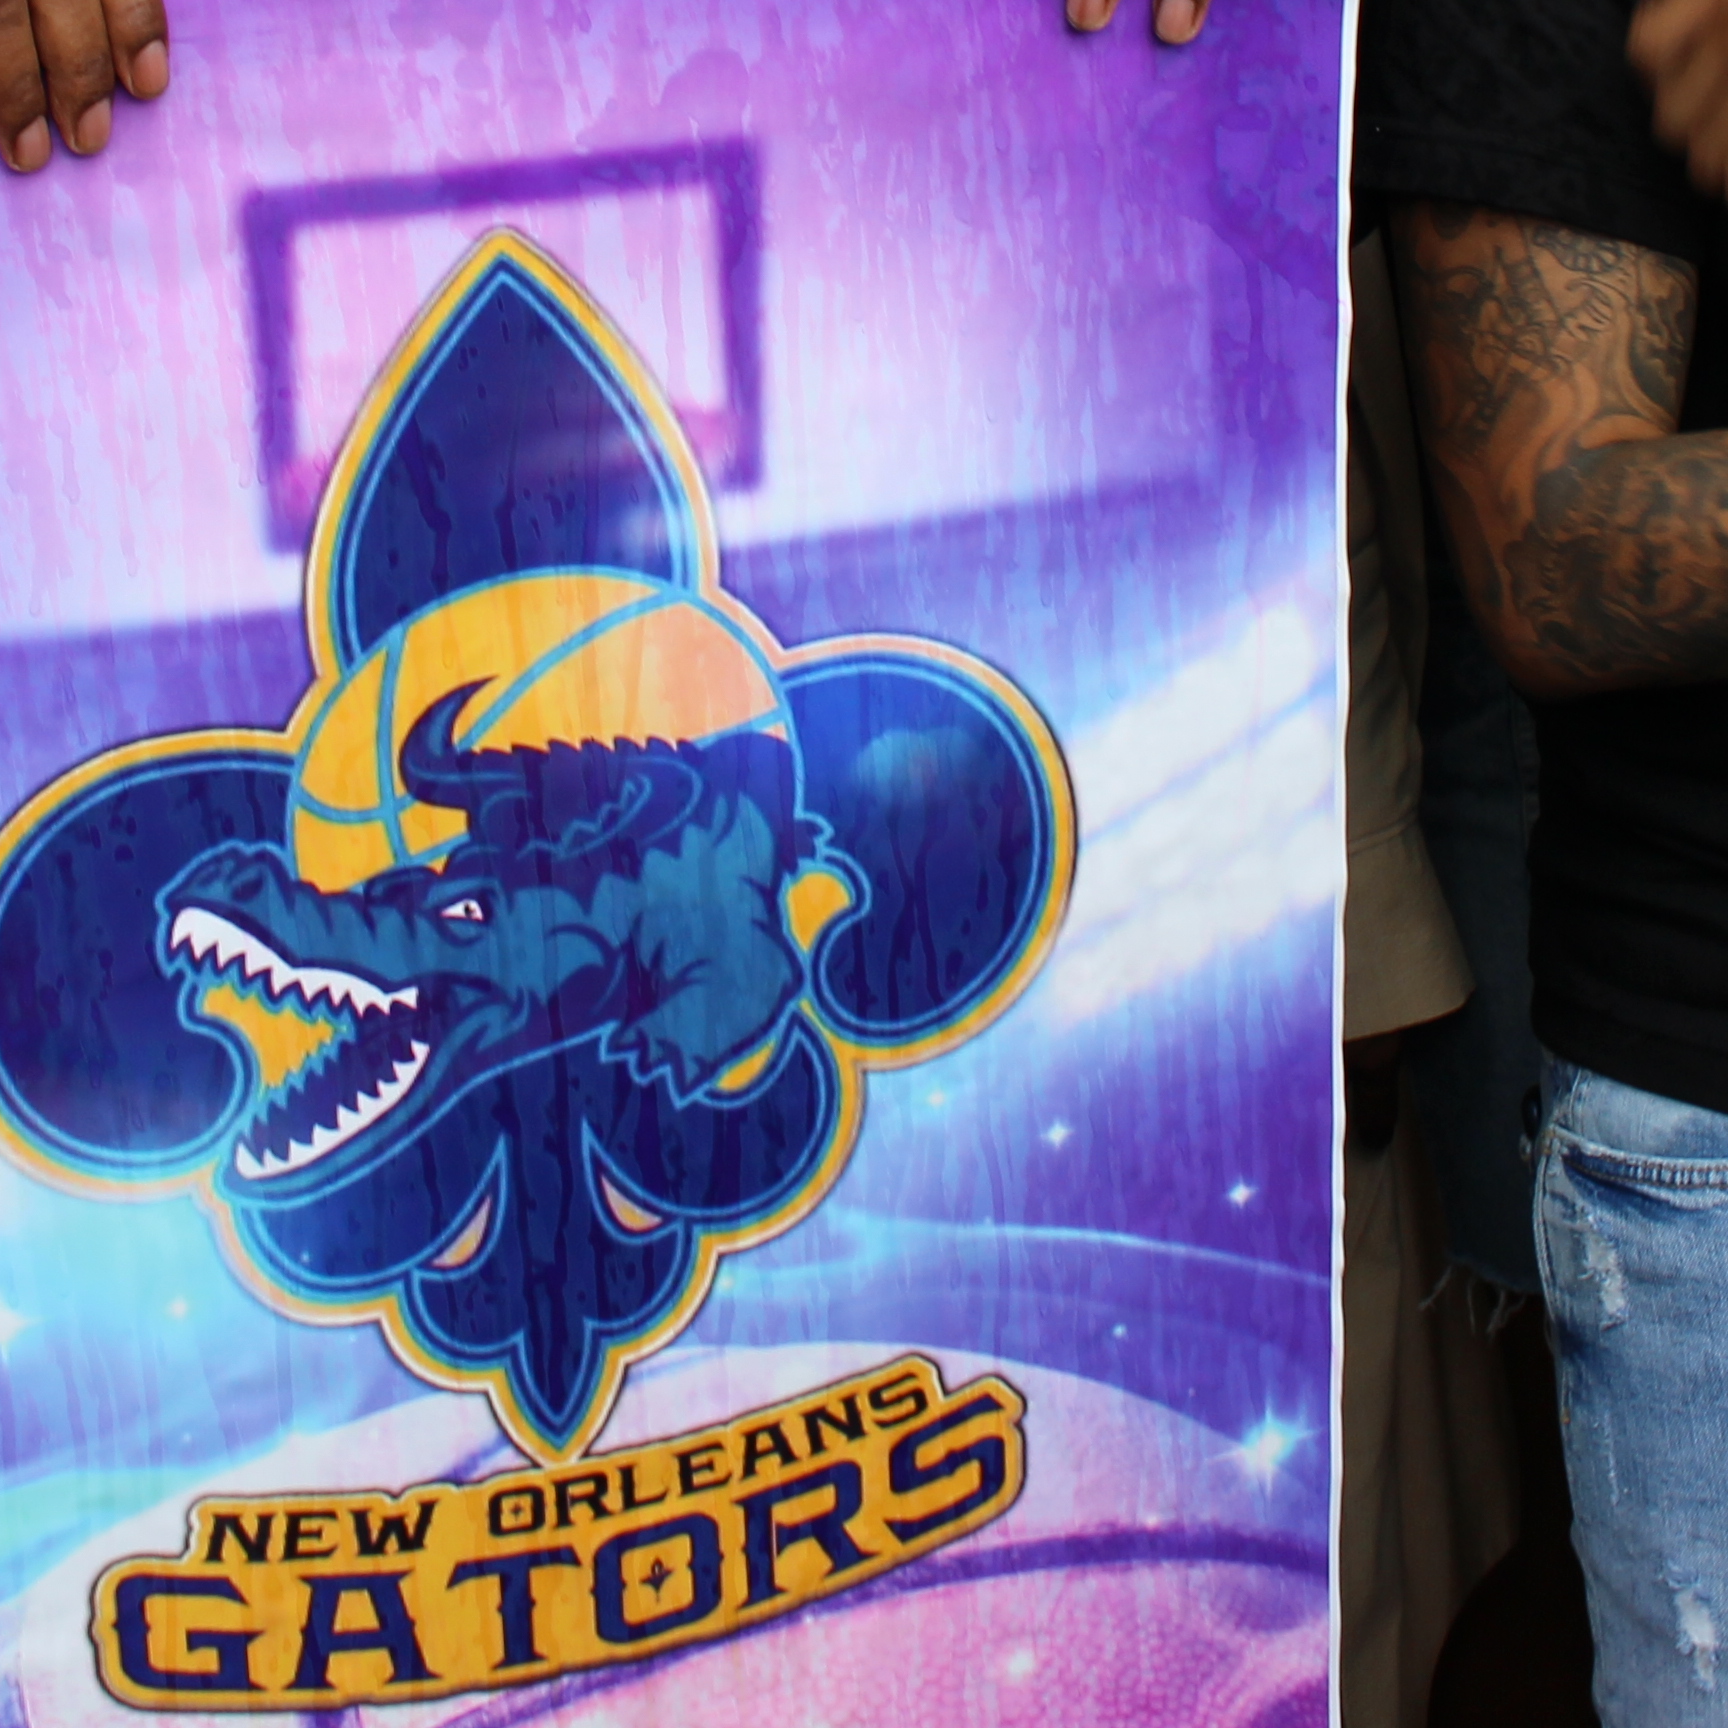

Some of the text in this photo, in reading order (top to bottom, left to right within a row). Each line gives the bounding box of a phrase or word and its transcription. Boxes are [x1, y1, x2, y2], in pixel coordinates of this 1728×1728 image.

[111, 1391, 1005, 1691] GATORS
[203, 1373, 930, 1563] NEW ORLEANS
